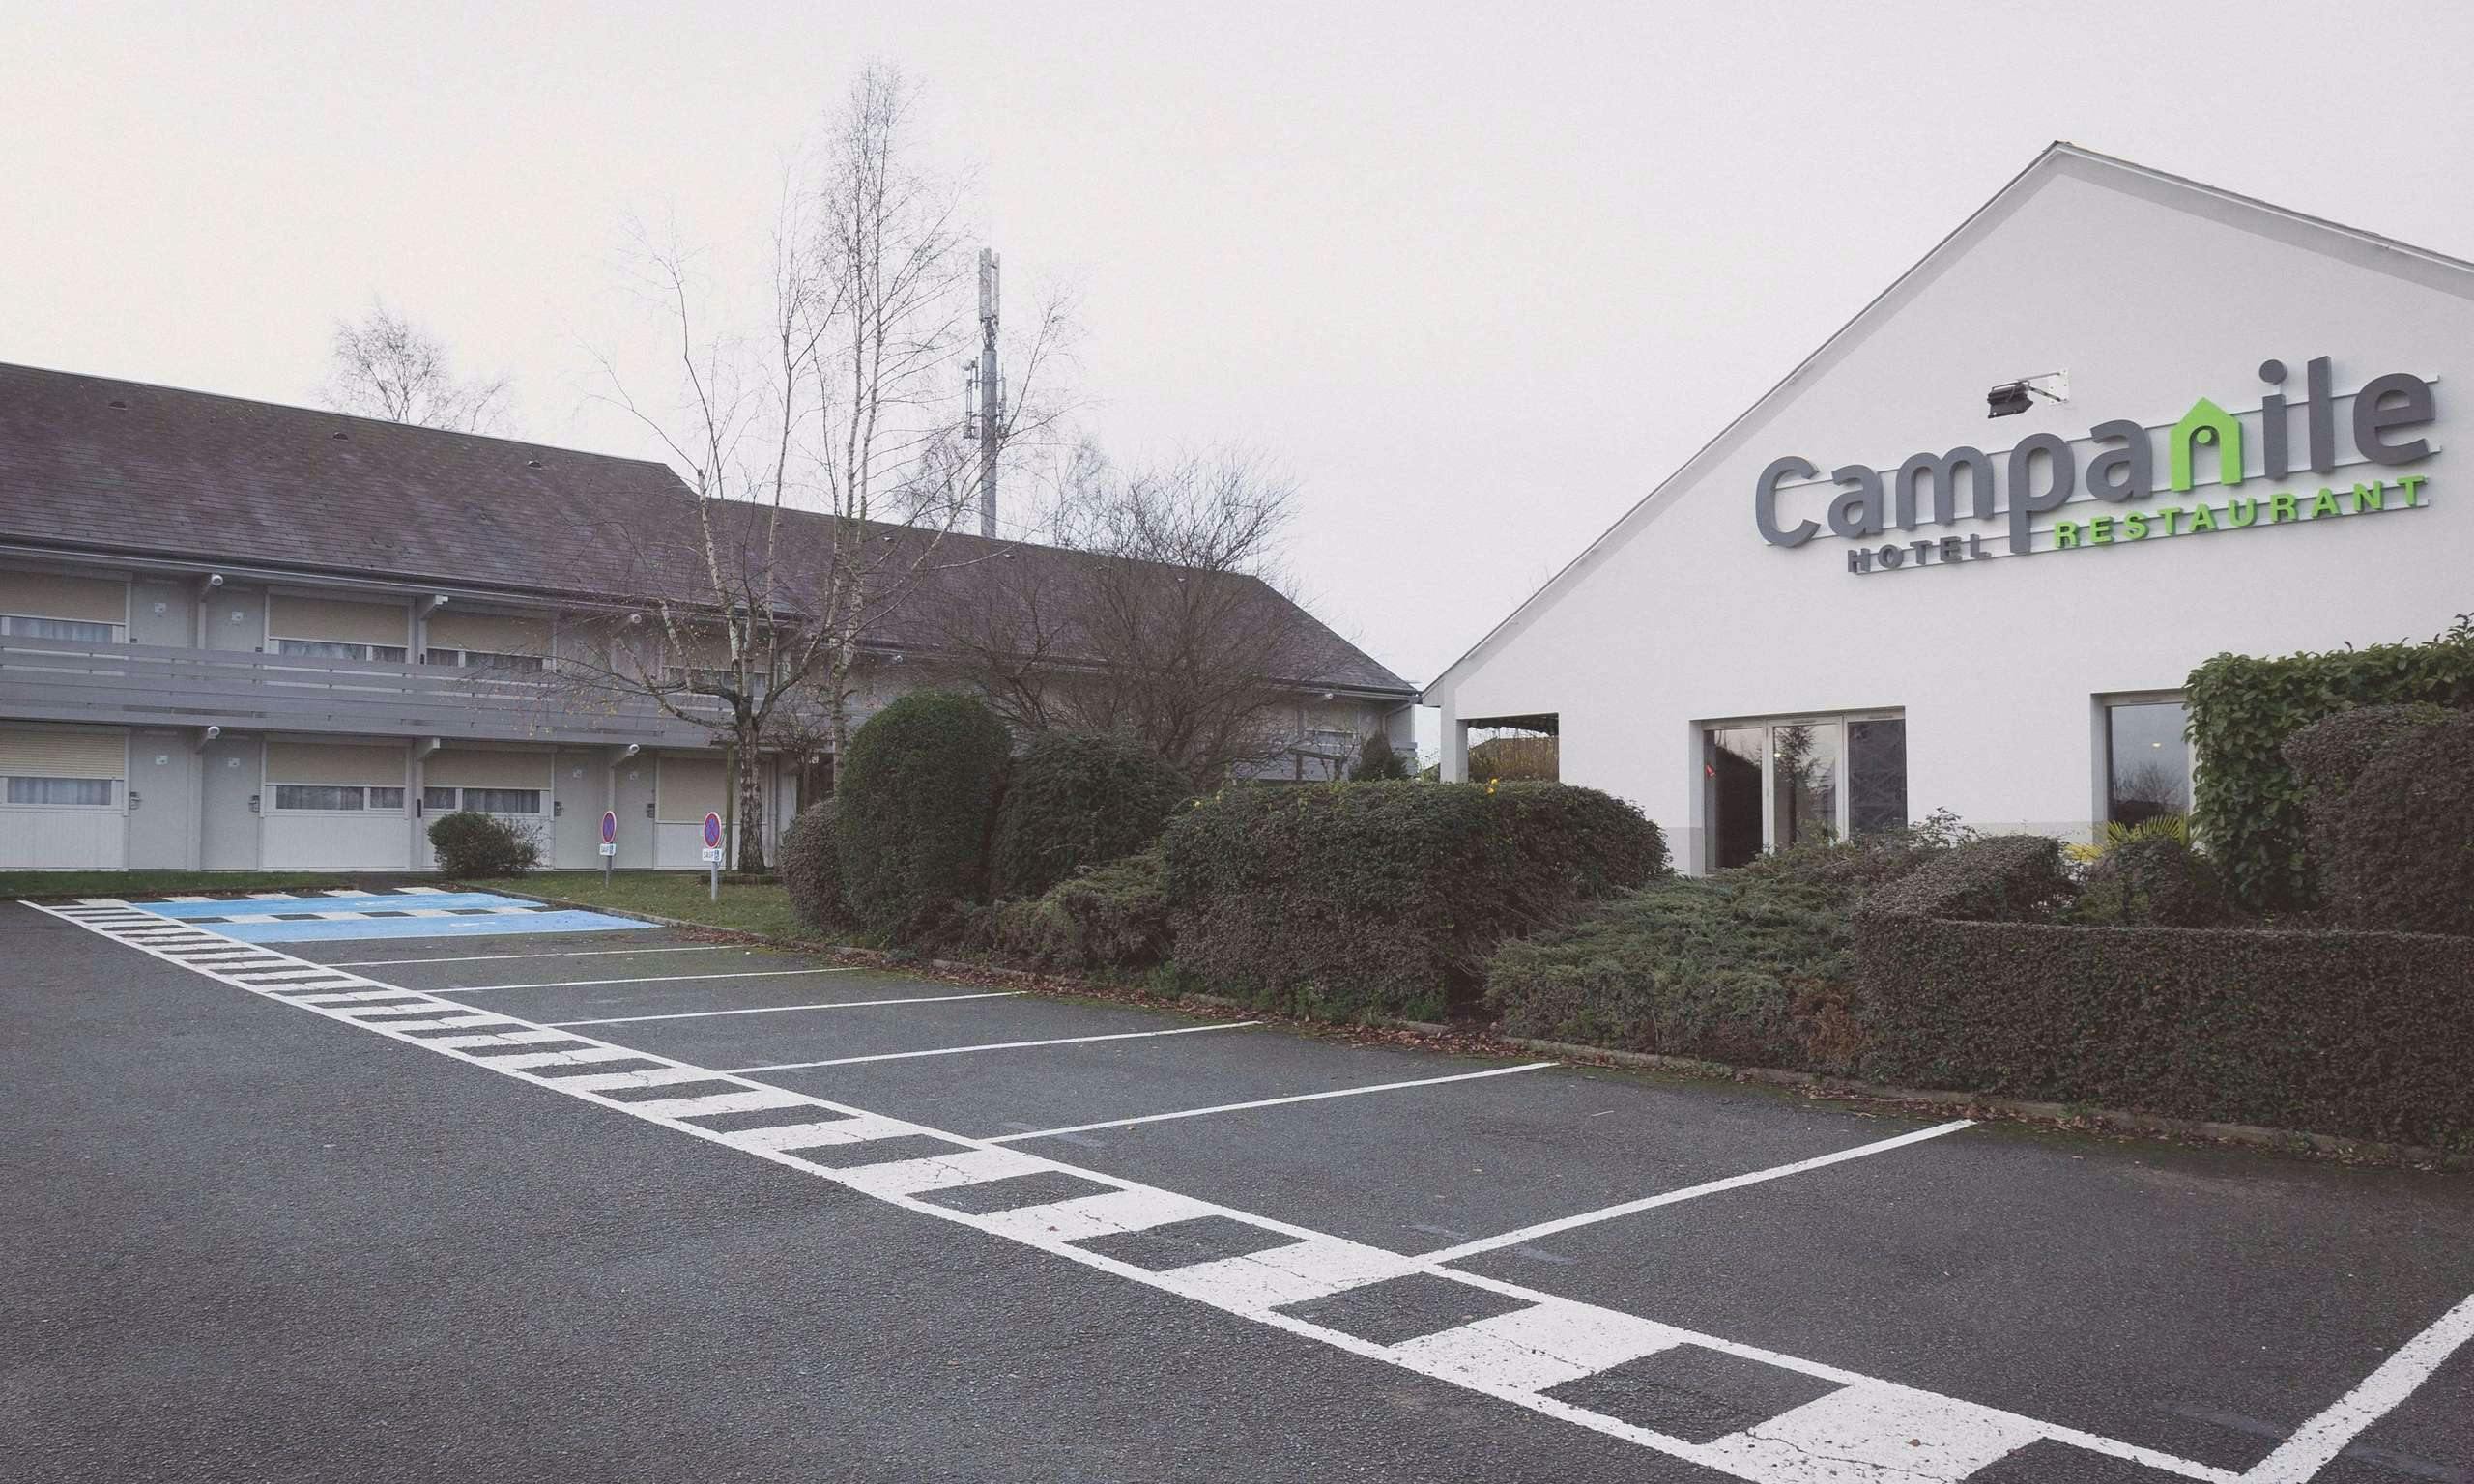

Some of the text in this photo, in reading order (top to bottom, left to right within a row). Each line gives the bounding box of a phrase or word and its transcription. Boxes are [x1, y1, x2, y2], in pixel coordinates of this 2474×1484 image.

[1755, 356, 2436, 554] Campanile
[1847, 474, 2426, 573] HOTEL RESTAURANT
